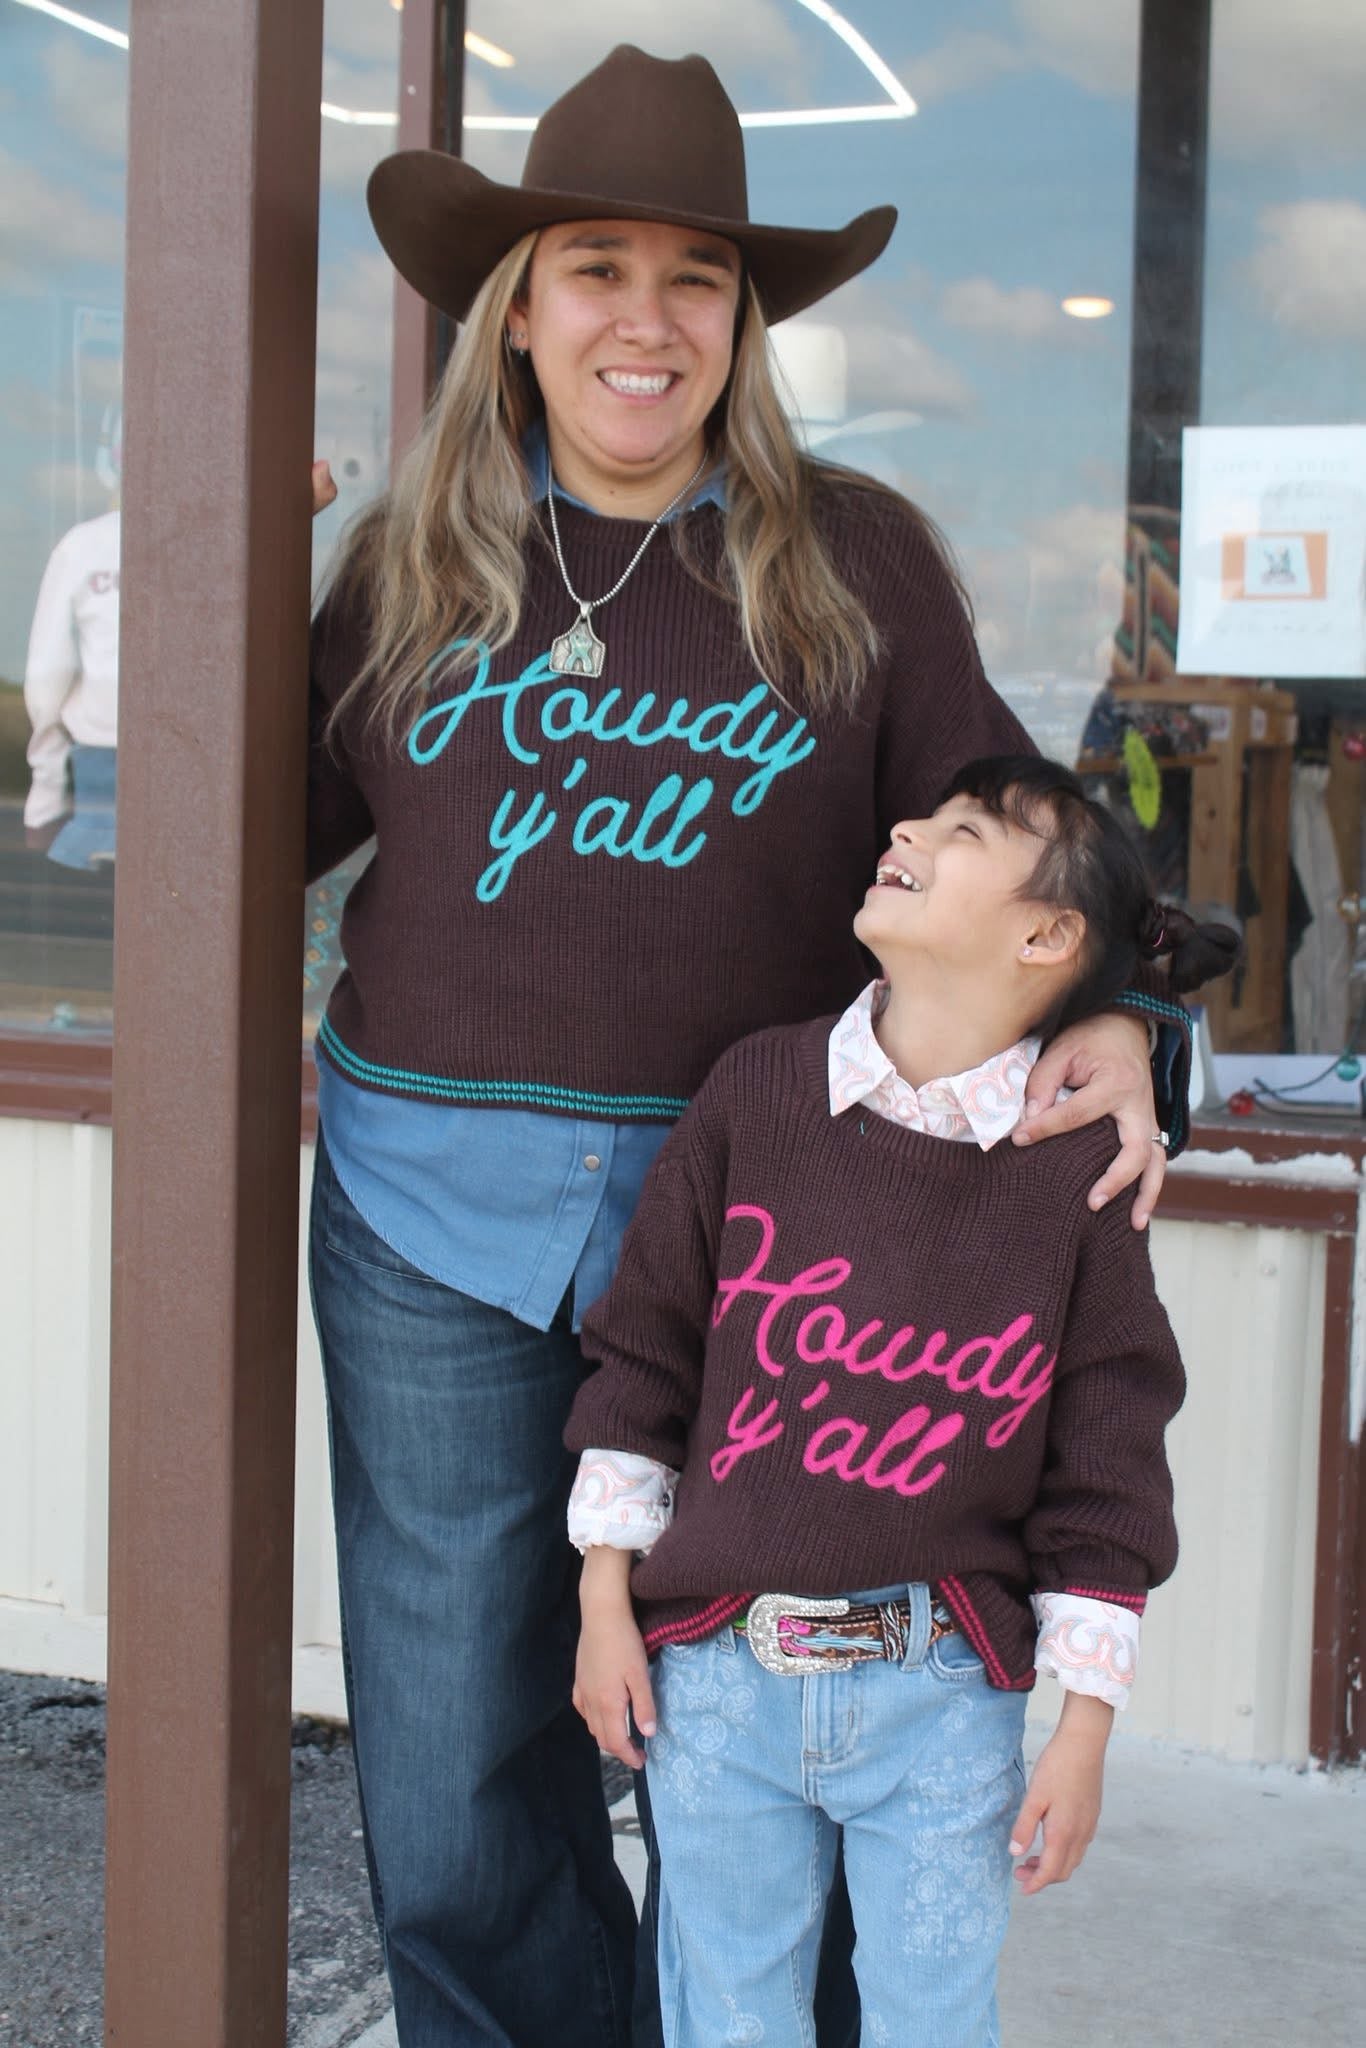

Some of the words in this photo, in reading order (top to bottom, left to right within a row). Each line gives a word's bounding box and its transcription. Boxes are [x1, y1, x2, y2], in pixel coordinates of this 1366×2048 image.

[408, 637, 817, 817] Howdy
[475, 757, 715, 903] y'all
[712, 1202, 1058, 1449] Howdy
[709, 1379, 967, 1498] y'all
